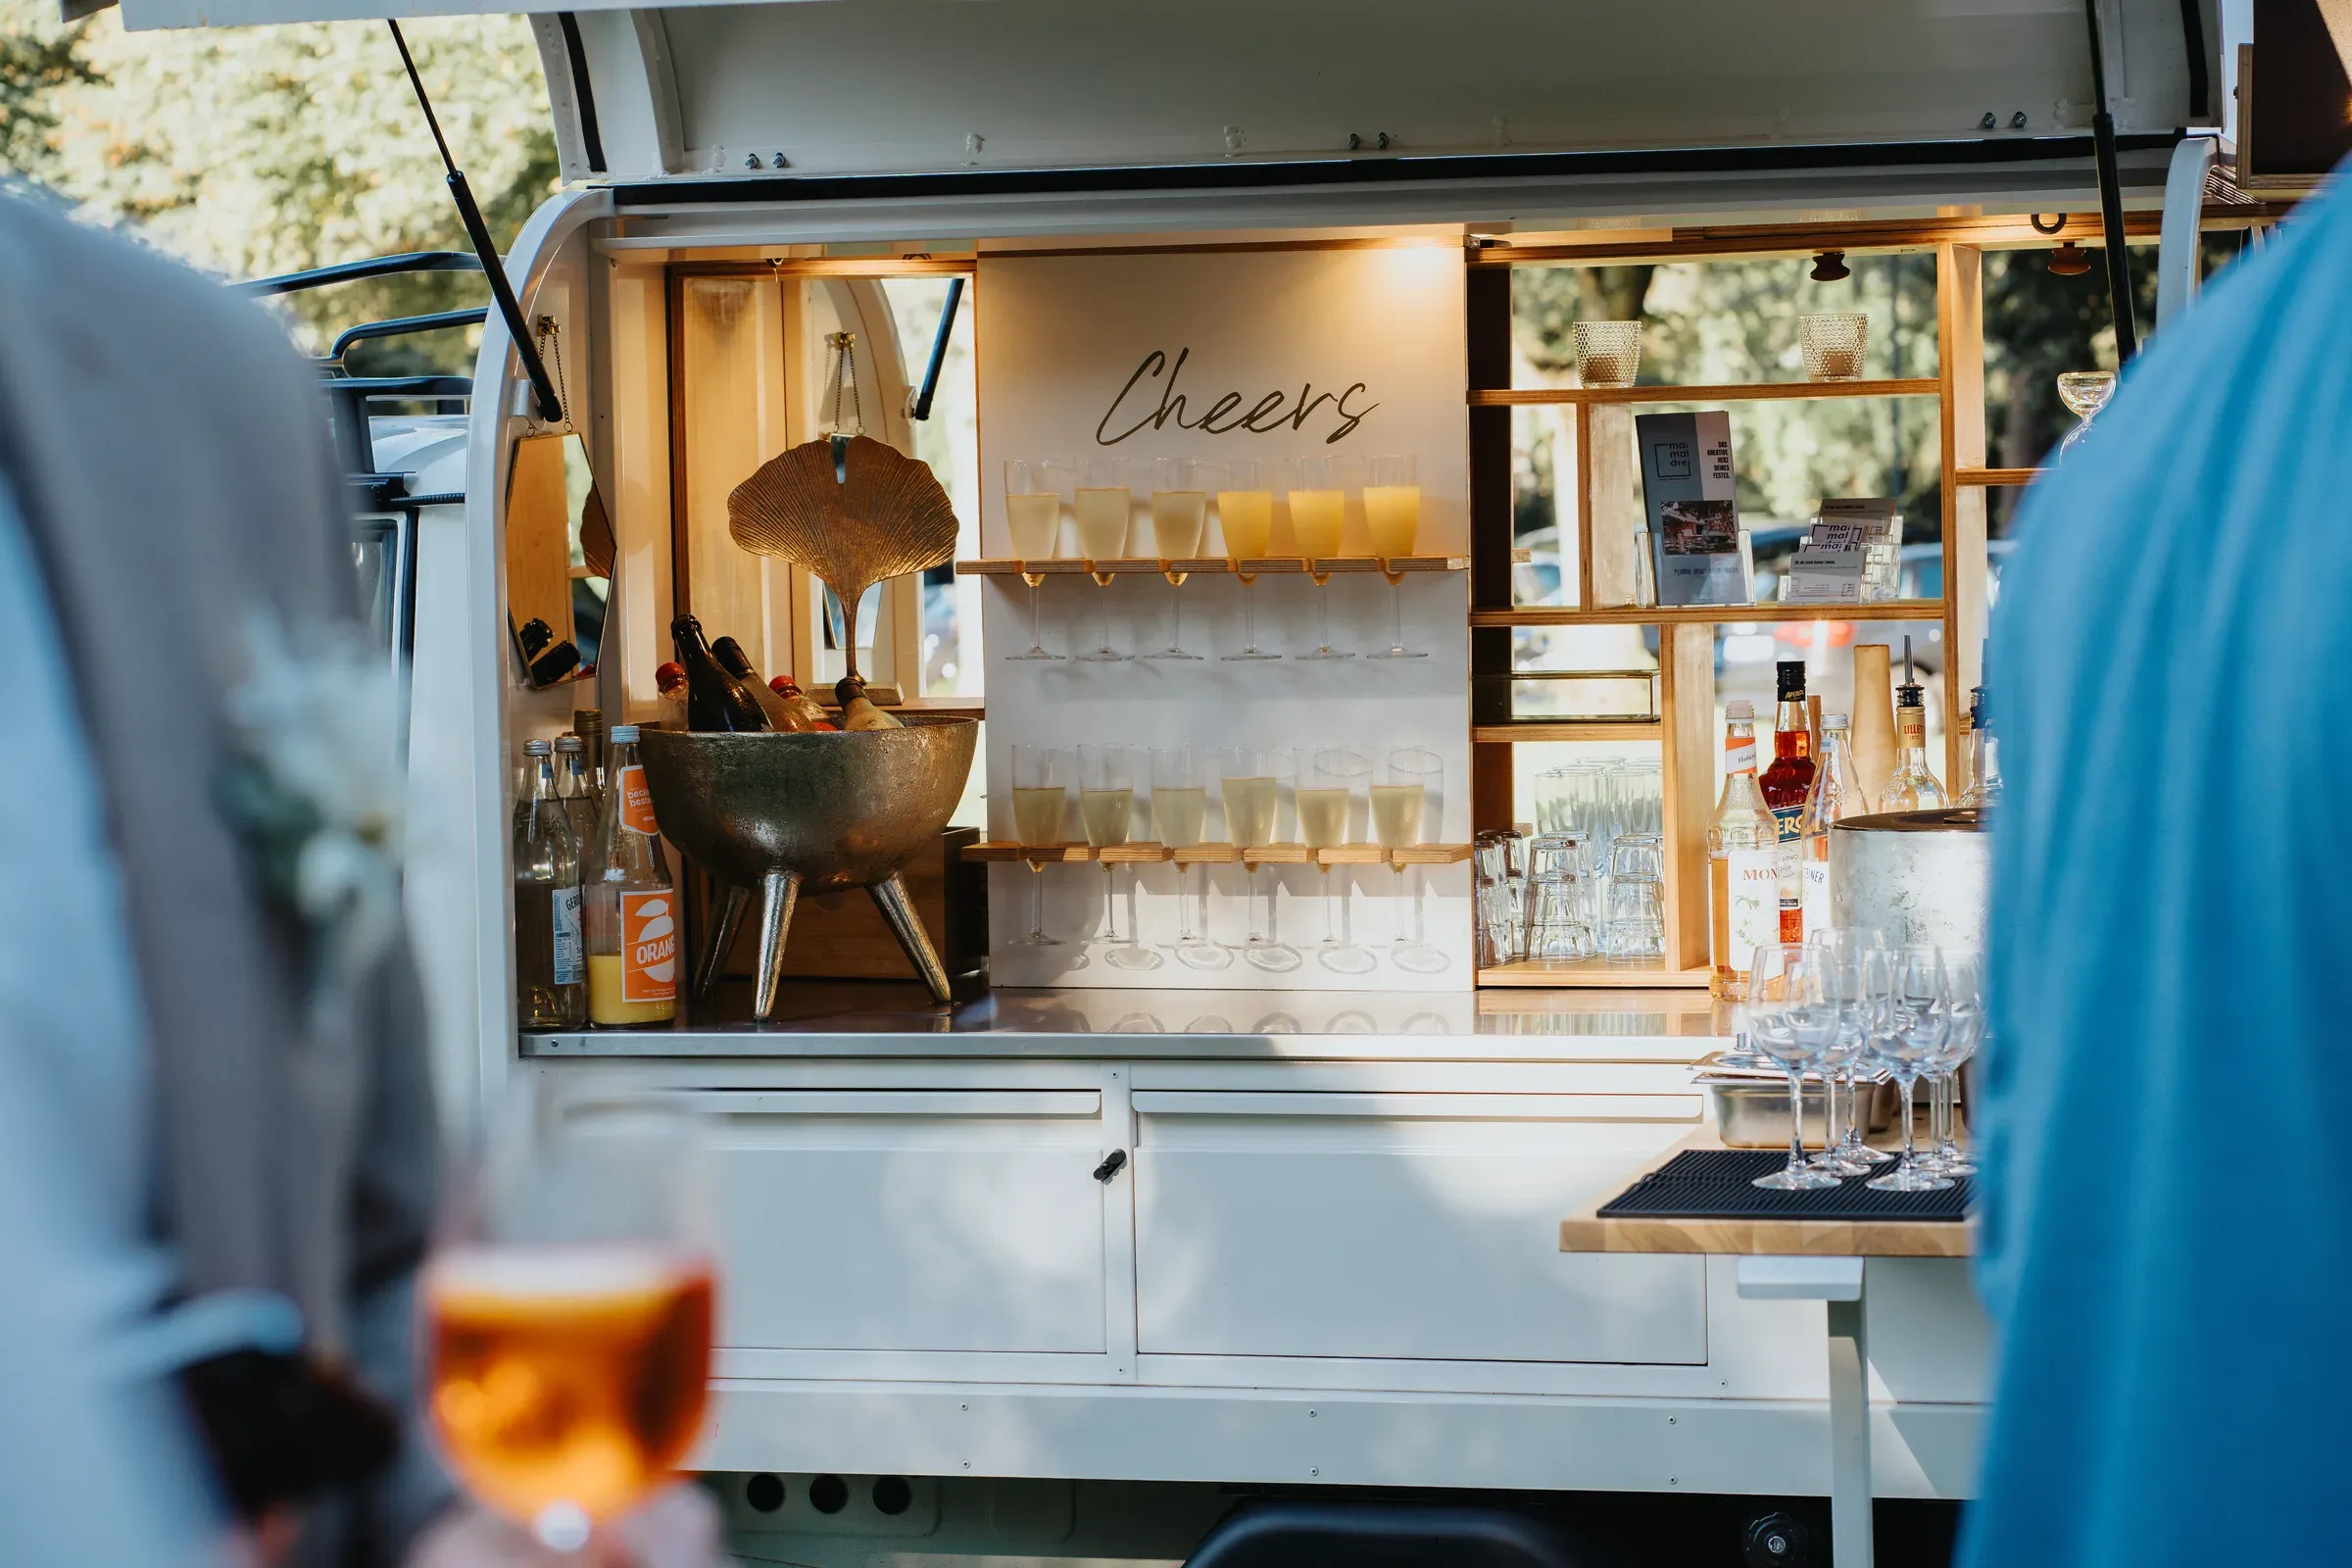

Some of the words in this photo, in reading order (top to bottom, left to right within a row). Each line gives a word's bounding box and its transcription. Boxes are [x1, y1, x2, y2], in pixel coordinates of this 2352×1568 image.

[1096, 347, 1380, 446] Cheers
[1827, 531, 1849, 540] mal
[1903, 723, 1924, 735] LILLET
